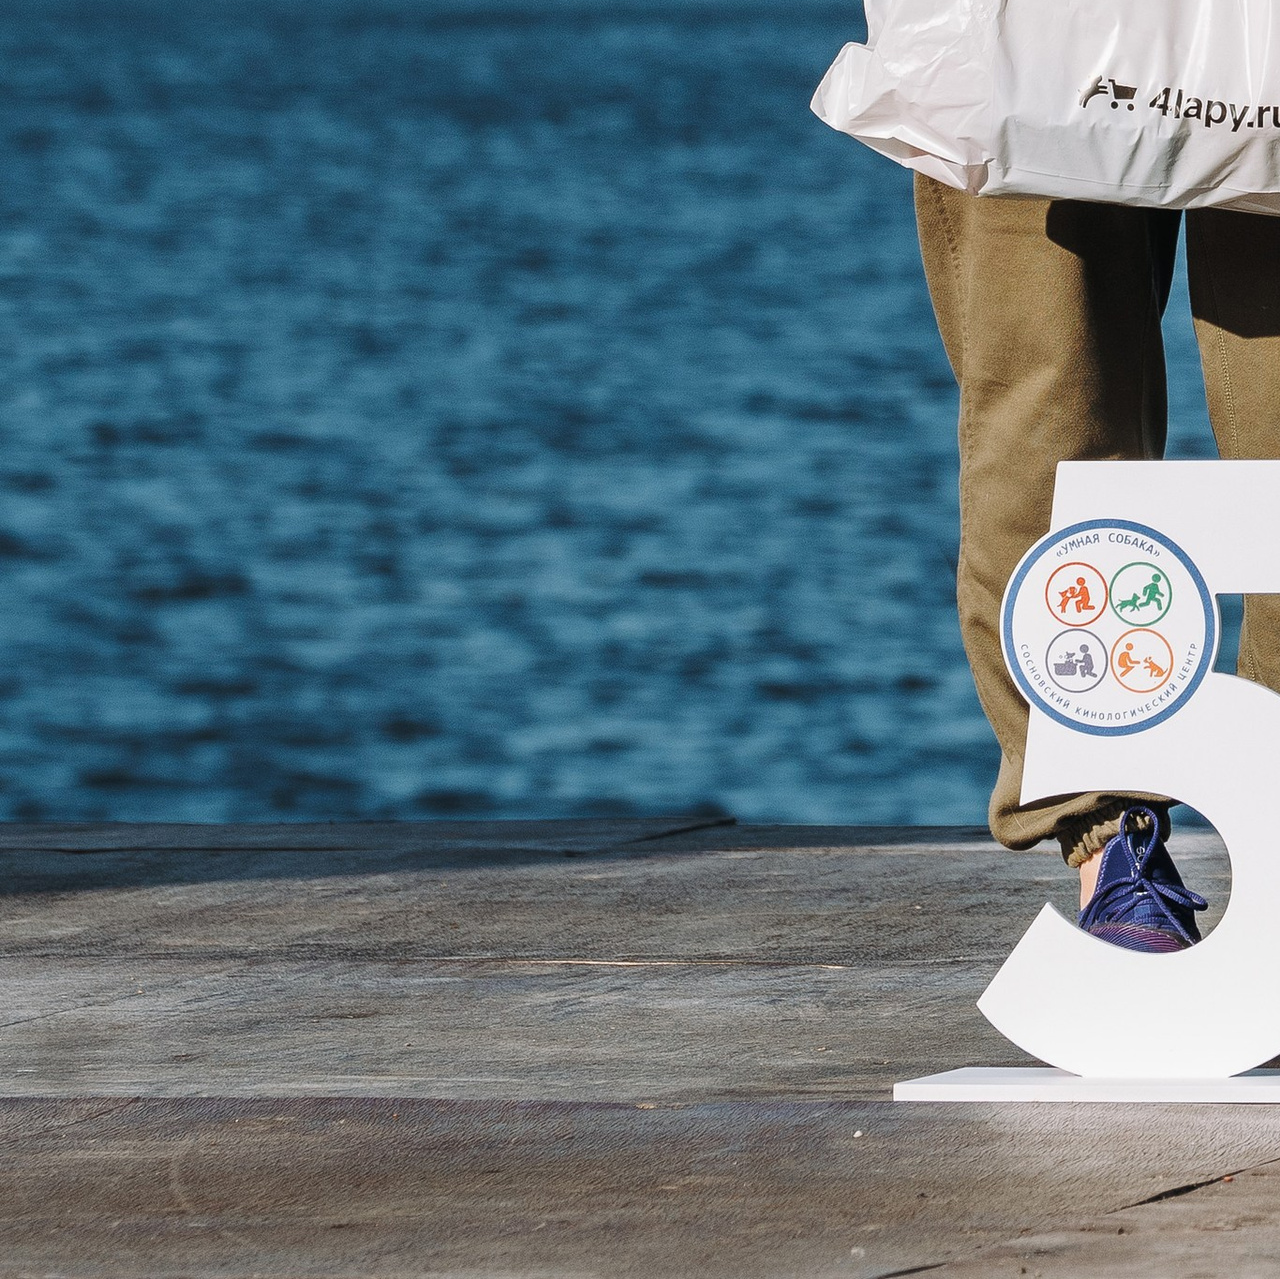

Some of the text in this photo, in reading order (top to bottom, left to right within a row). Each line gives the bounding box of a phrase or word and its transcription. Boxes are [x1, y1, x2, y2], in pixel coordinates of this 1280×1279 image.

[1055, 532, 1161, 559] «УМНАЯ СОБАКА»
[1020, 642, 1199, 721] СОСНОВСКИЙ КИНОЛОГИЧЕСКИЙ ЦЕНТР
